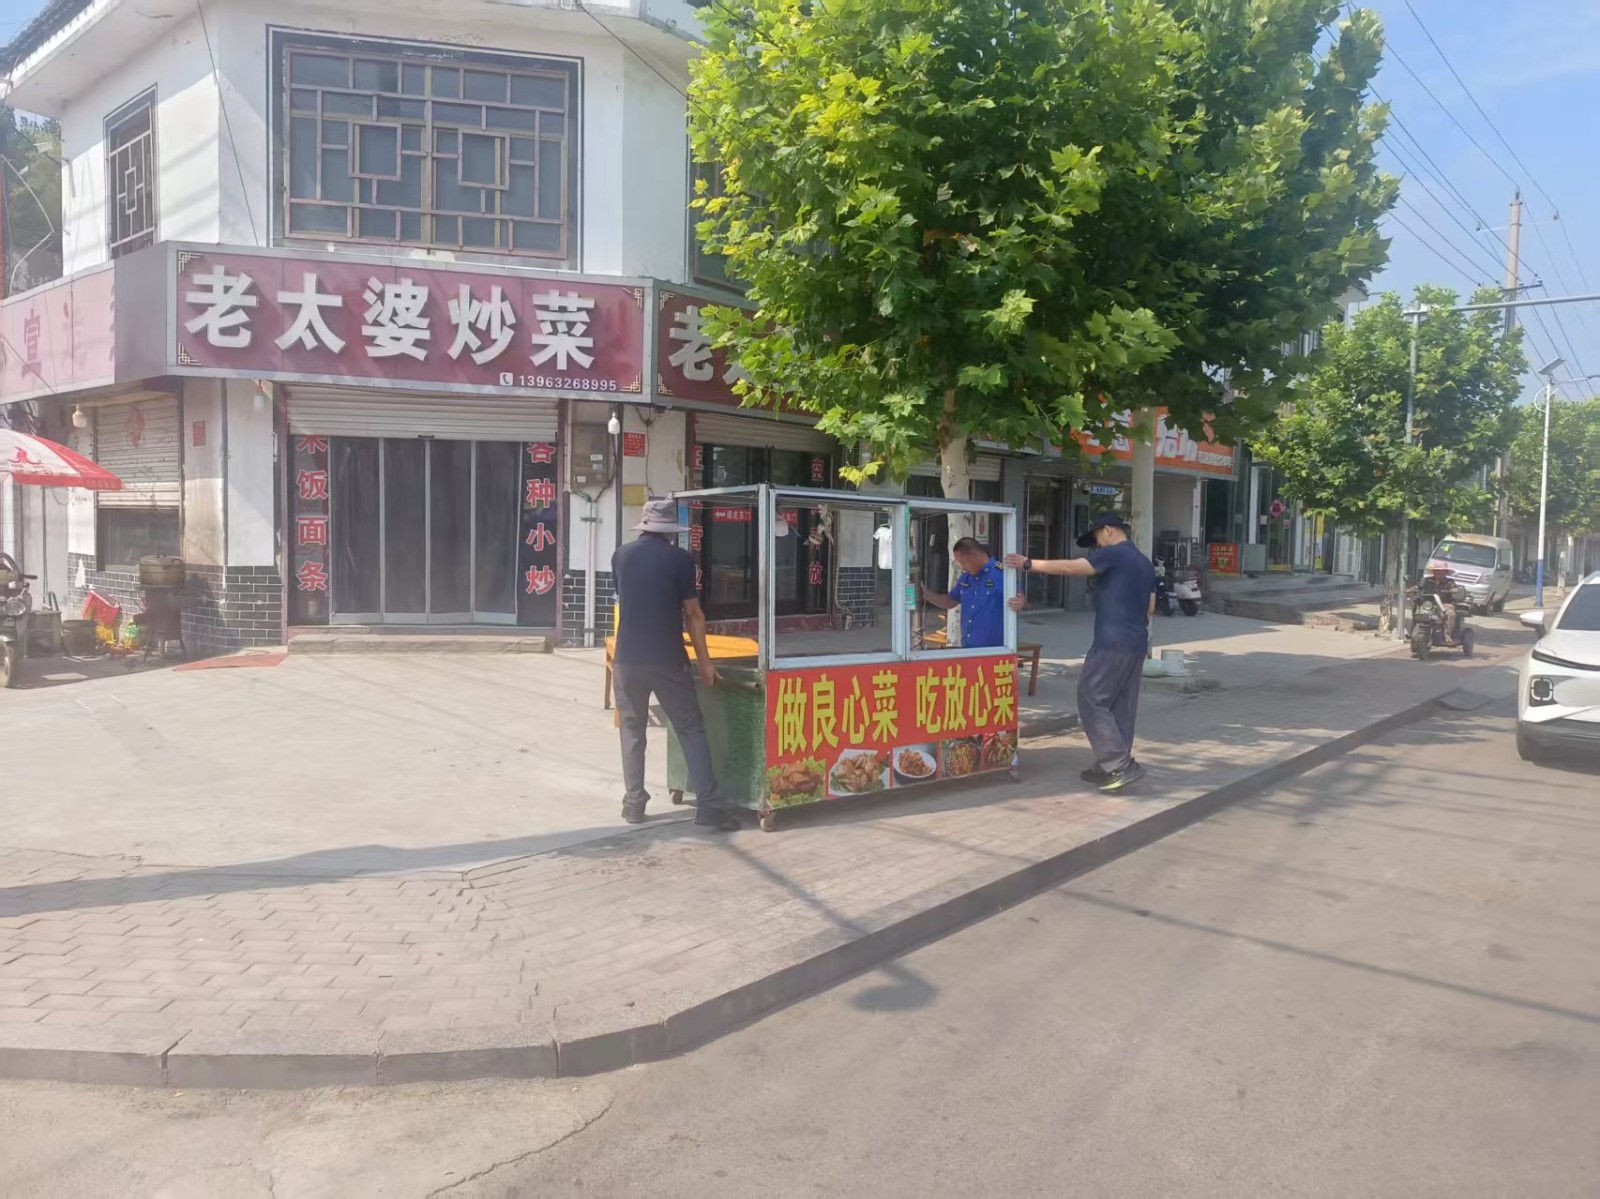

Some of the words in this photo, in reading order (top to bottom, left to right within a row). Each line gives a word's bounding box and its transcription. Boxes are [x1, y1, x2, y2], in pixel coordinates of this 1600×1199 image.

[184, 264, 596, 371] 老太婆炒菜
[518, 374, 618, 392] 13963268995
[525, 441, 557, 596] 各种小炒
[773, 669, 900, 757] 做良心菜
[915, 659, 1015, 735] 吃放心菜
